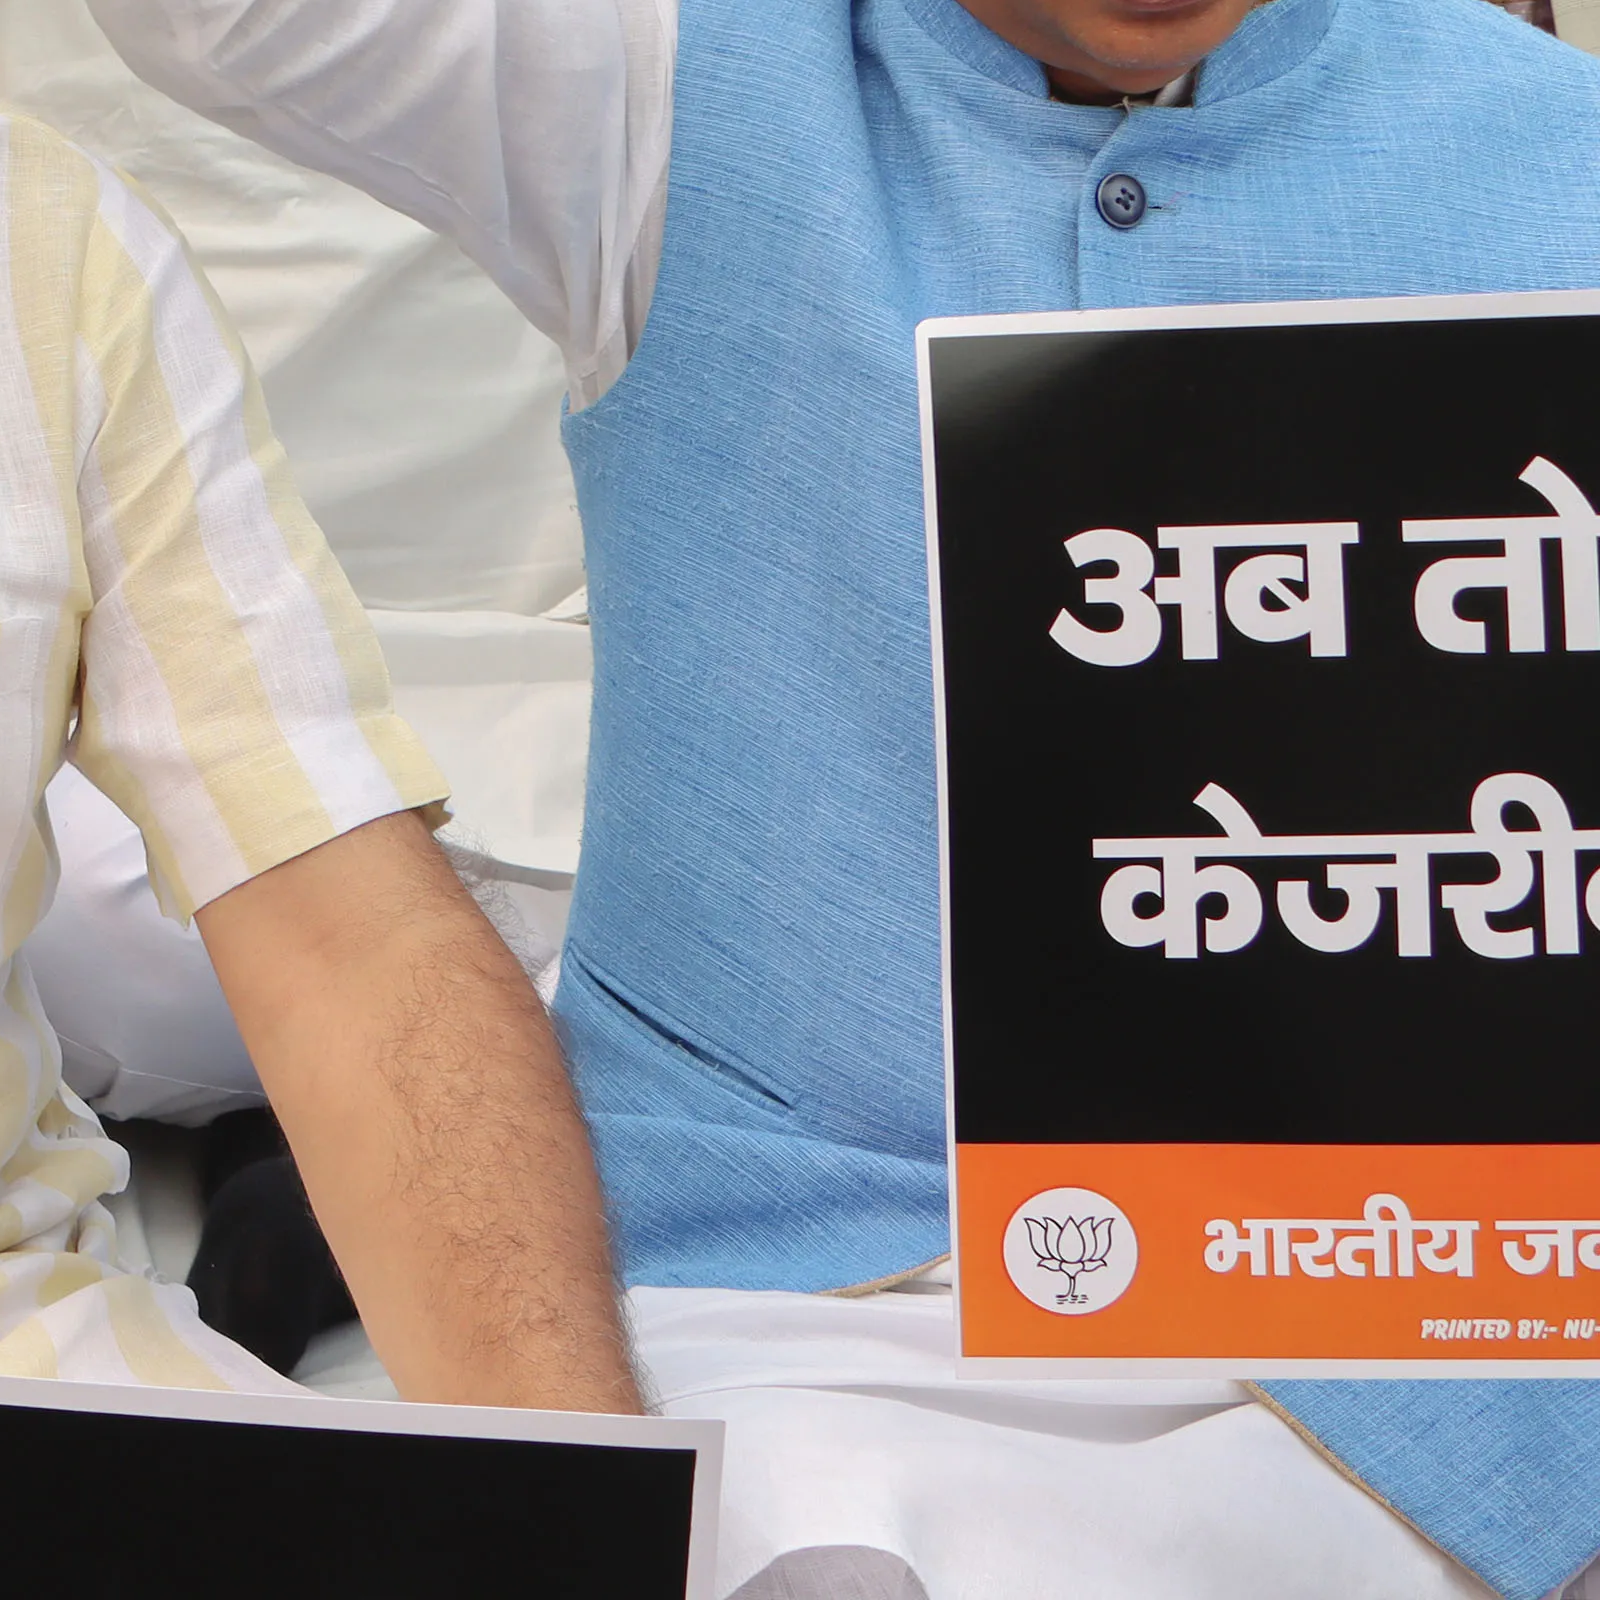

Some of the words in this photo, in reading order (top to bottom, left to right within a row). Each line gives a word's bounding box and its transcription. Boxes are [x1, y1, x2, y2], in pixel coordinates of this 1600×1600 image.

[1049, 521, 1359, 667] अब
[1402, 455, 1600, 655] तो
[1203, 1192, 1480, 1278] भारतीय
[1420, 1318, 1510, 1340] PRINTED
